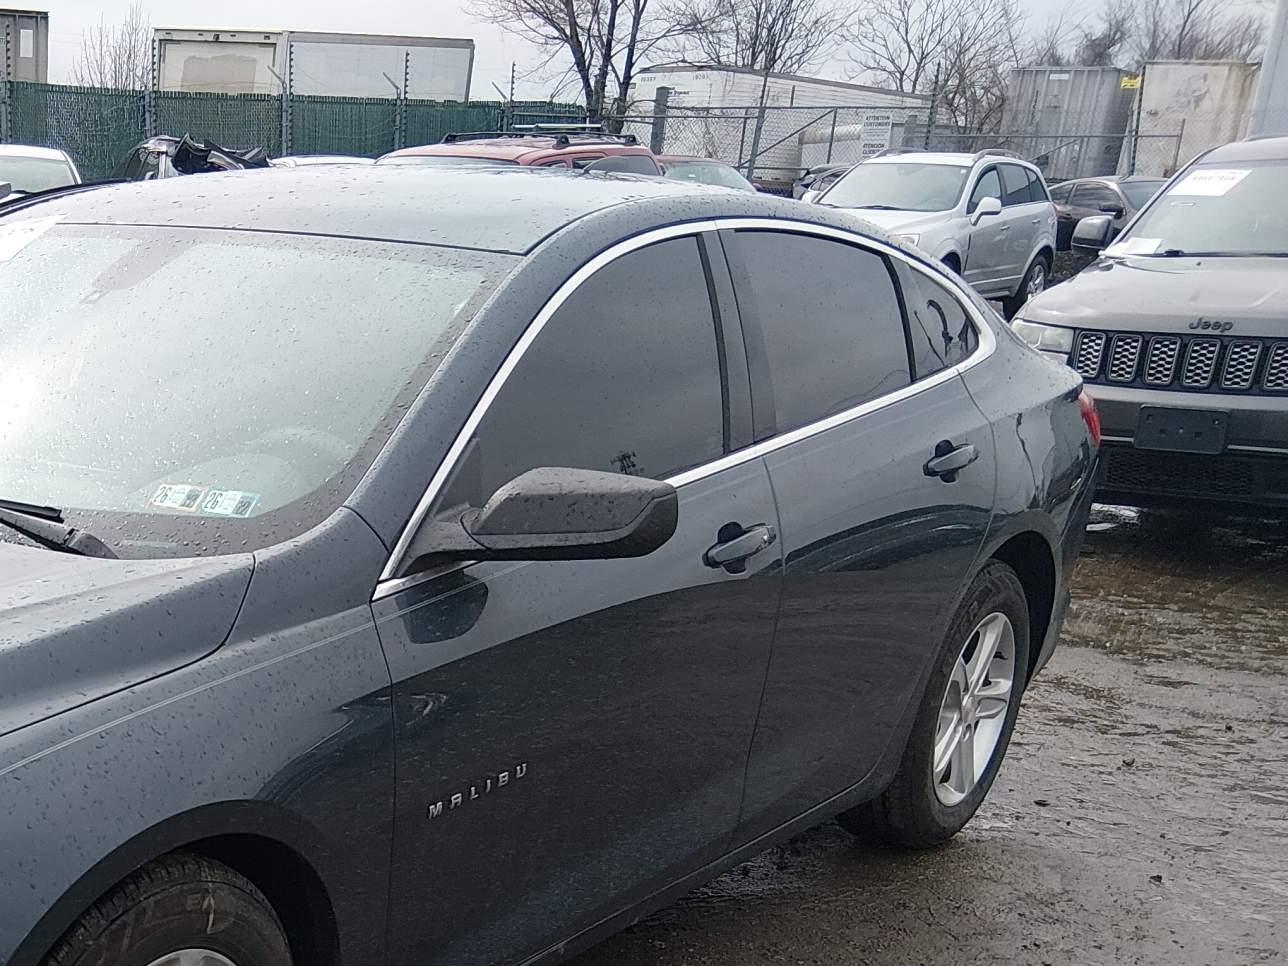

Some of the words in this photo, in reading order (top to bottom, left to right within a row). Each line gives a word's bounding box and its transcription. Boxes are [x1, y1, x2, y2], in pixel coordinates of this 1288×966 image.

[1188, 316, 1234, 333] Jeep
[153, 485, 173, 504] 26
[203, 492, 223, 510] 26
[428, 762, 528, 819] MALIBU
